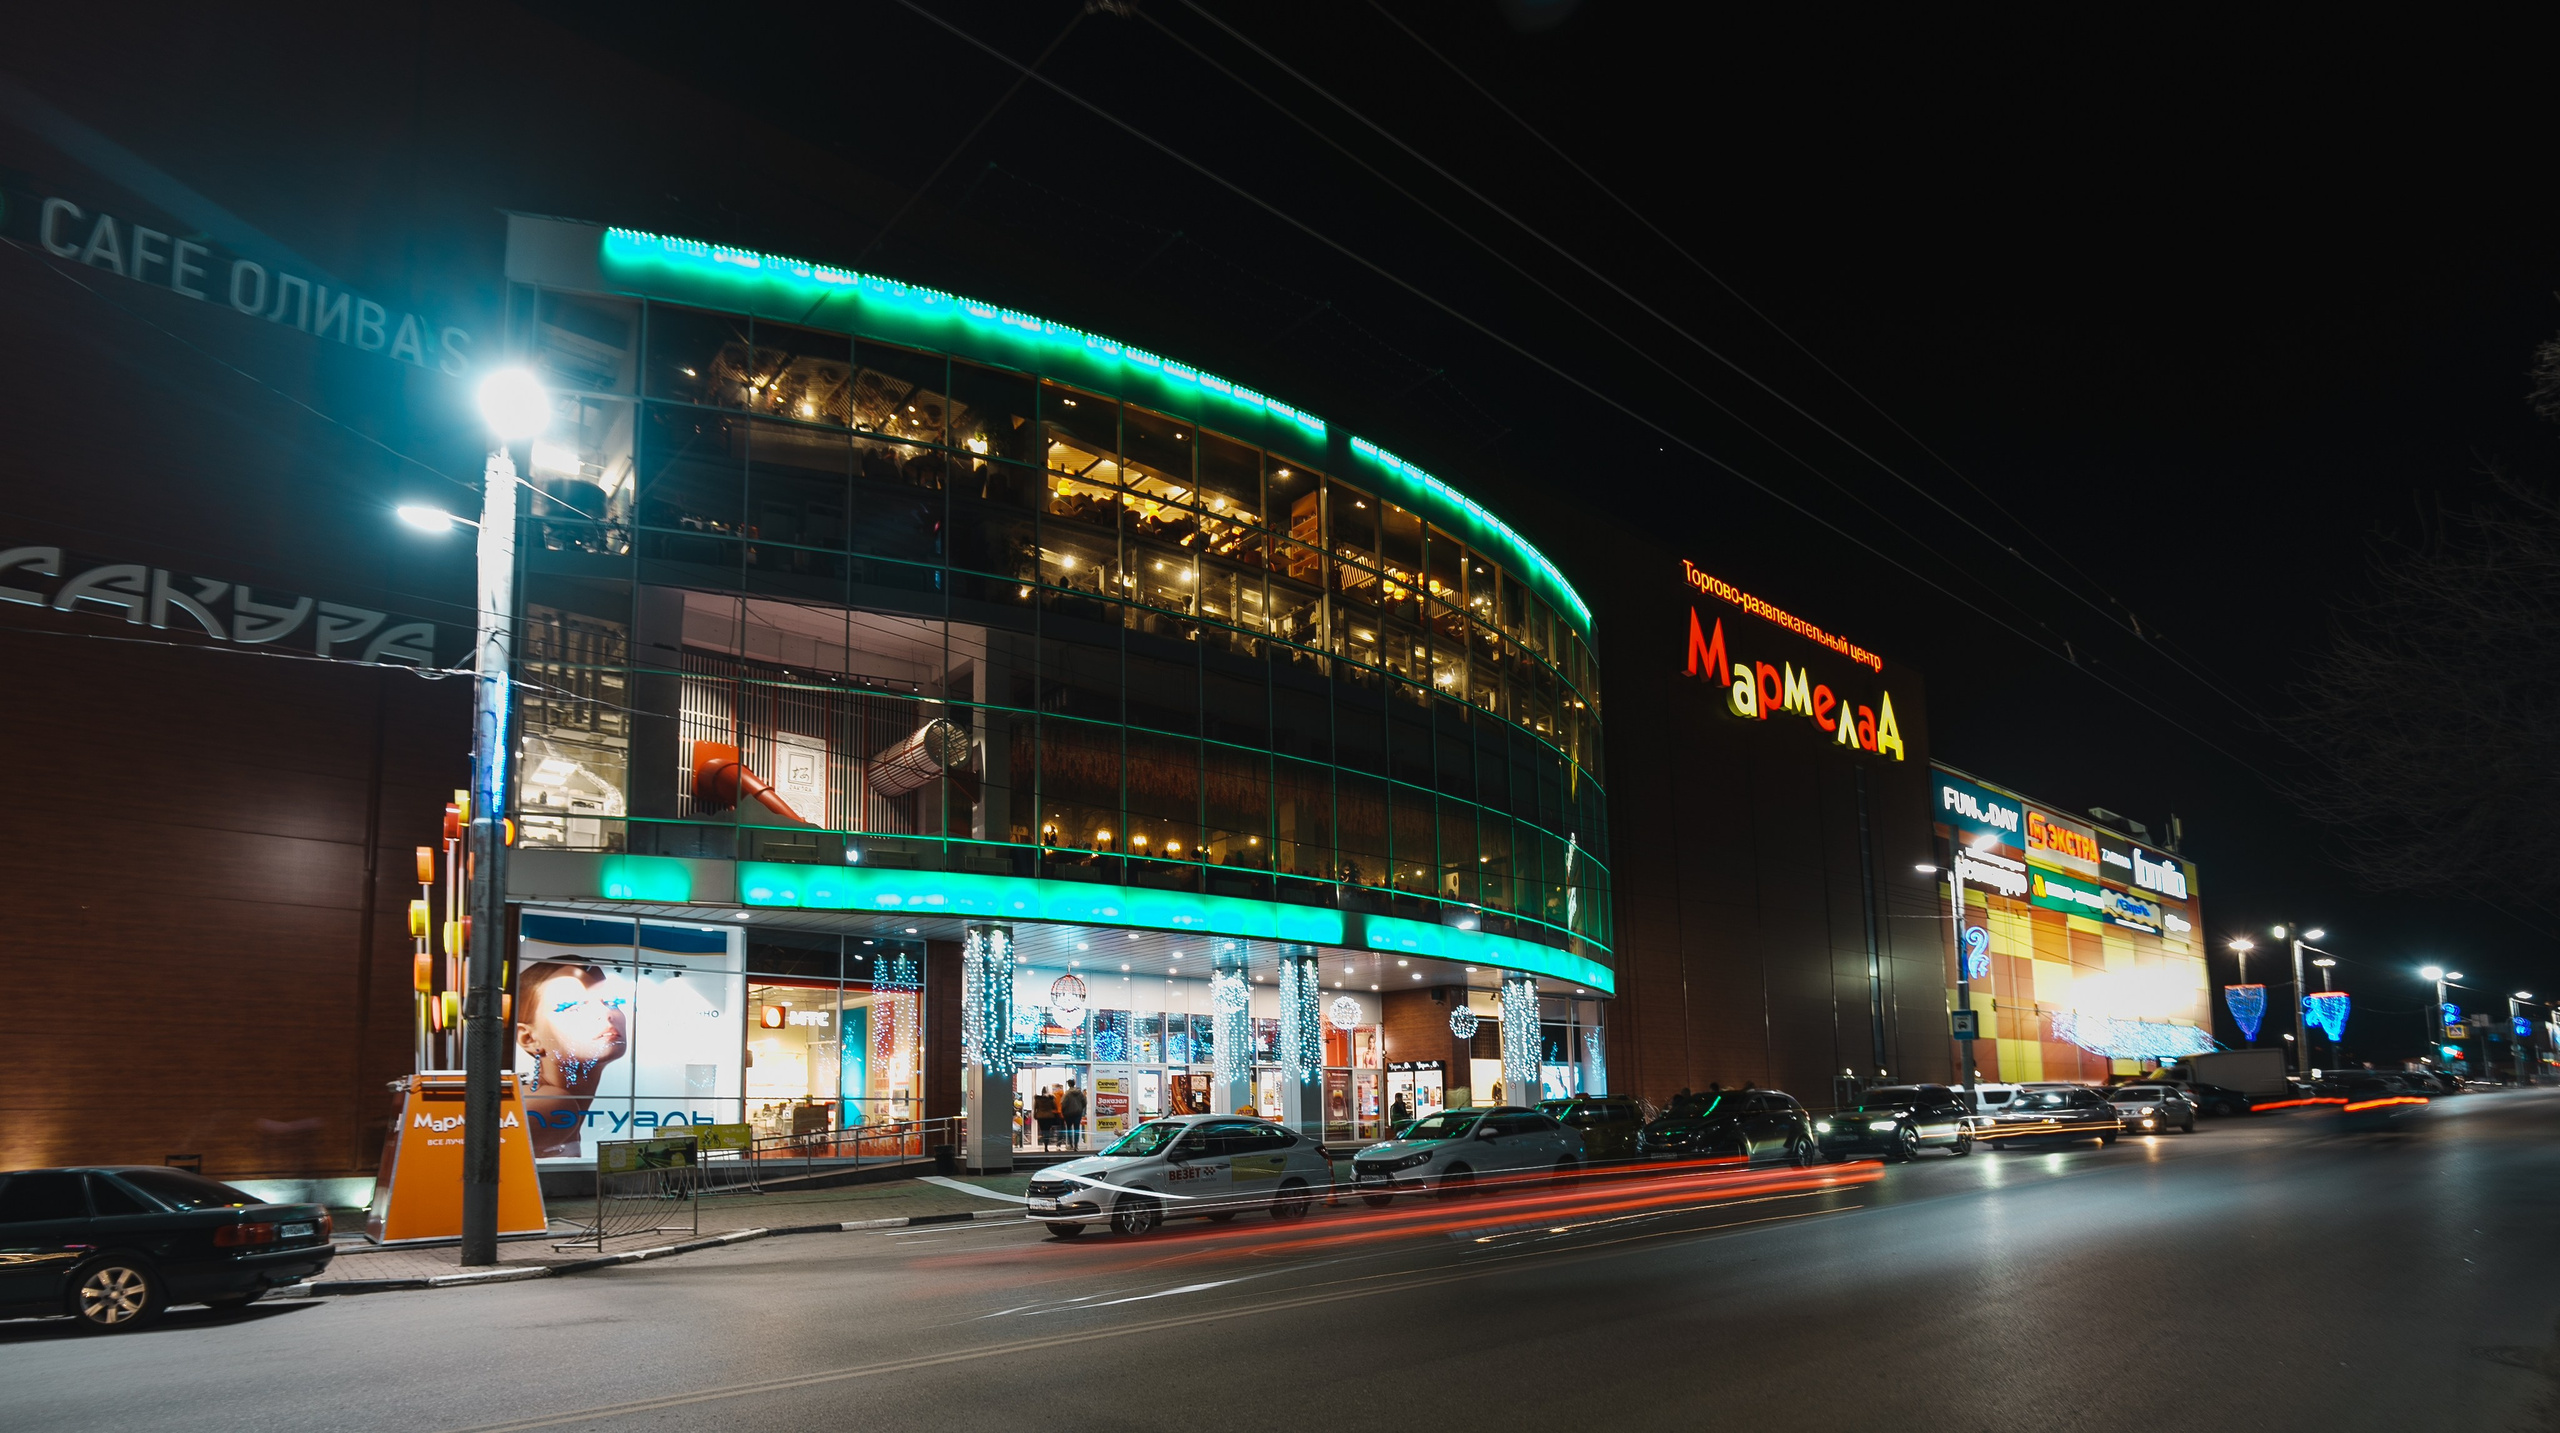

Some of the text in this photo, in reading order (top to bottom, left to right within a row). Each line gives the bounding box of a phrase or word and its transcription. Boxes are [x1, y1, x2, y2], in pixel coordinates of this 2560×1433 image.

[1681, 558, 1883, 673] Торгово-развлекательный центр
[2046, 823, 2101, 864] ЭКСТРА
[789, 1011, 829, 1026] МТС
[1097, 1097, 1128, 1105] Заказал
[427, 1138, 443, 1146] ВСЕ
[1168, 1165, 1201, 1181] ВЕЗЁТ
